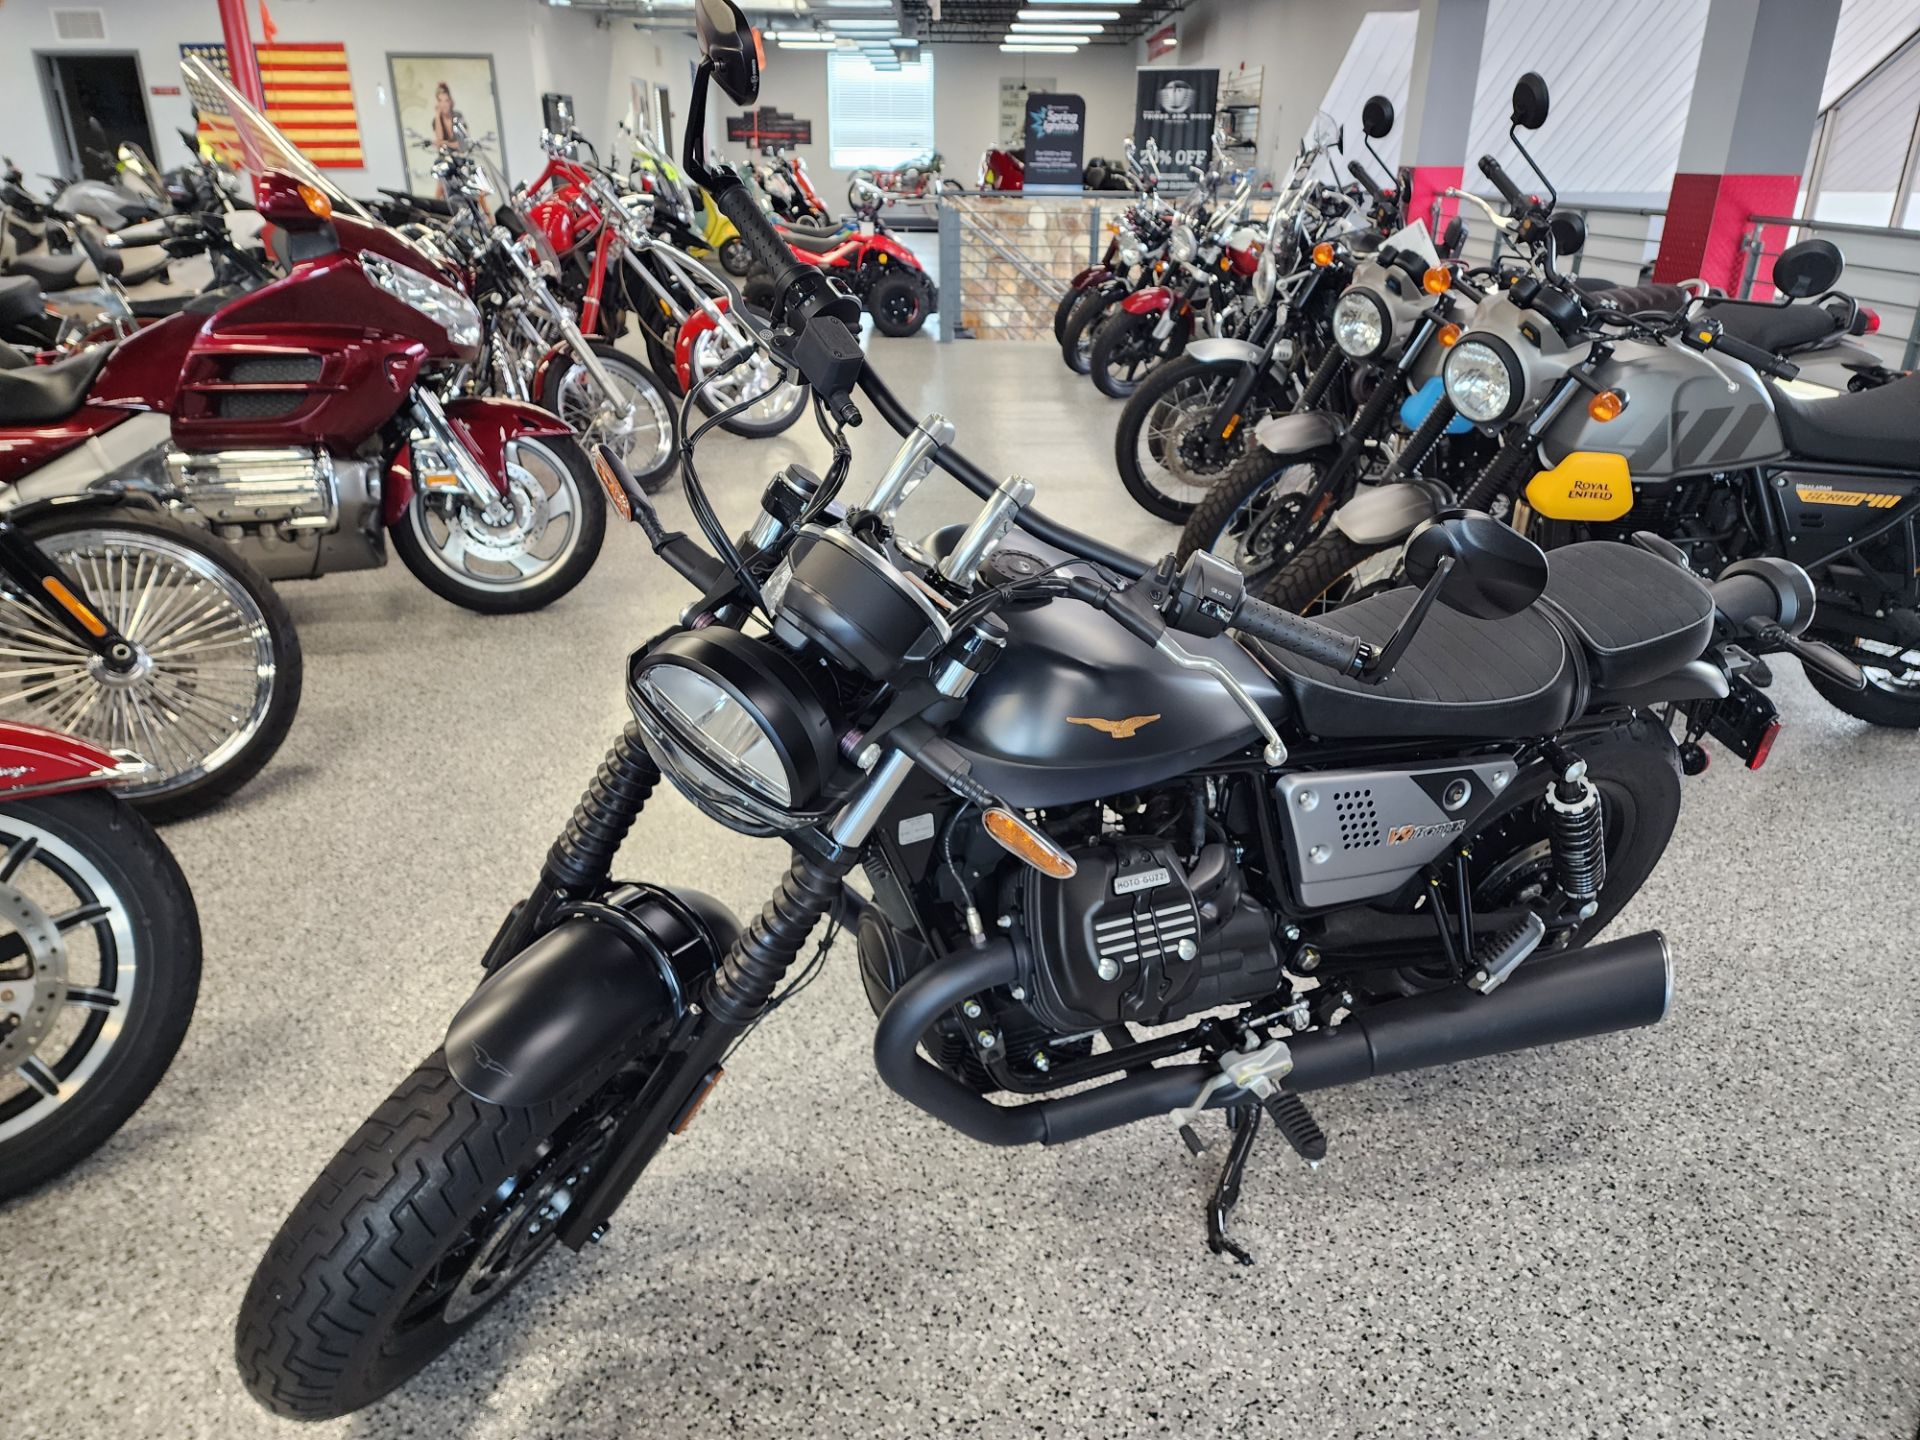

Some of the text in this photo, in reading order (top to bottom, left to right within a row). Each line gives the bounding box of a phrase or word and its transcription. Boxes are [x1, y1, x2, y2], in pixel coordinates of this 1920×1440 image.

[1047, 110, 1078, 124] Spring
[1043, 120, 1079, 134] Ignition
[1175, 149, 1208, 166] OFF
[1574, 480, 1609, 491] ROYAL
[1568, 490, 1613, 501] ENFIELD
[1117, 872, 1167, 890] MOTO GUZZI
